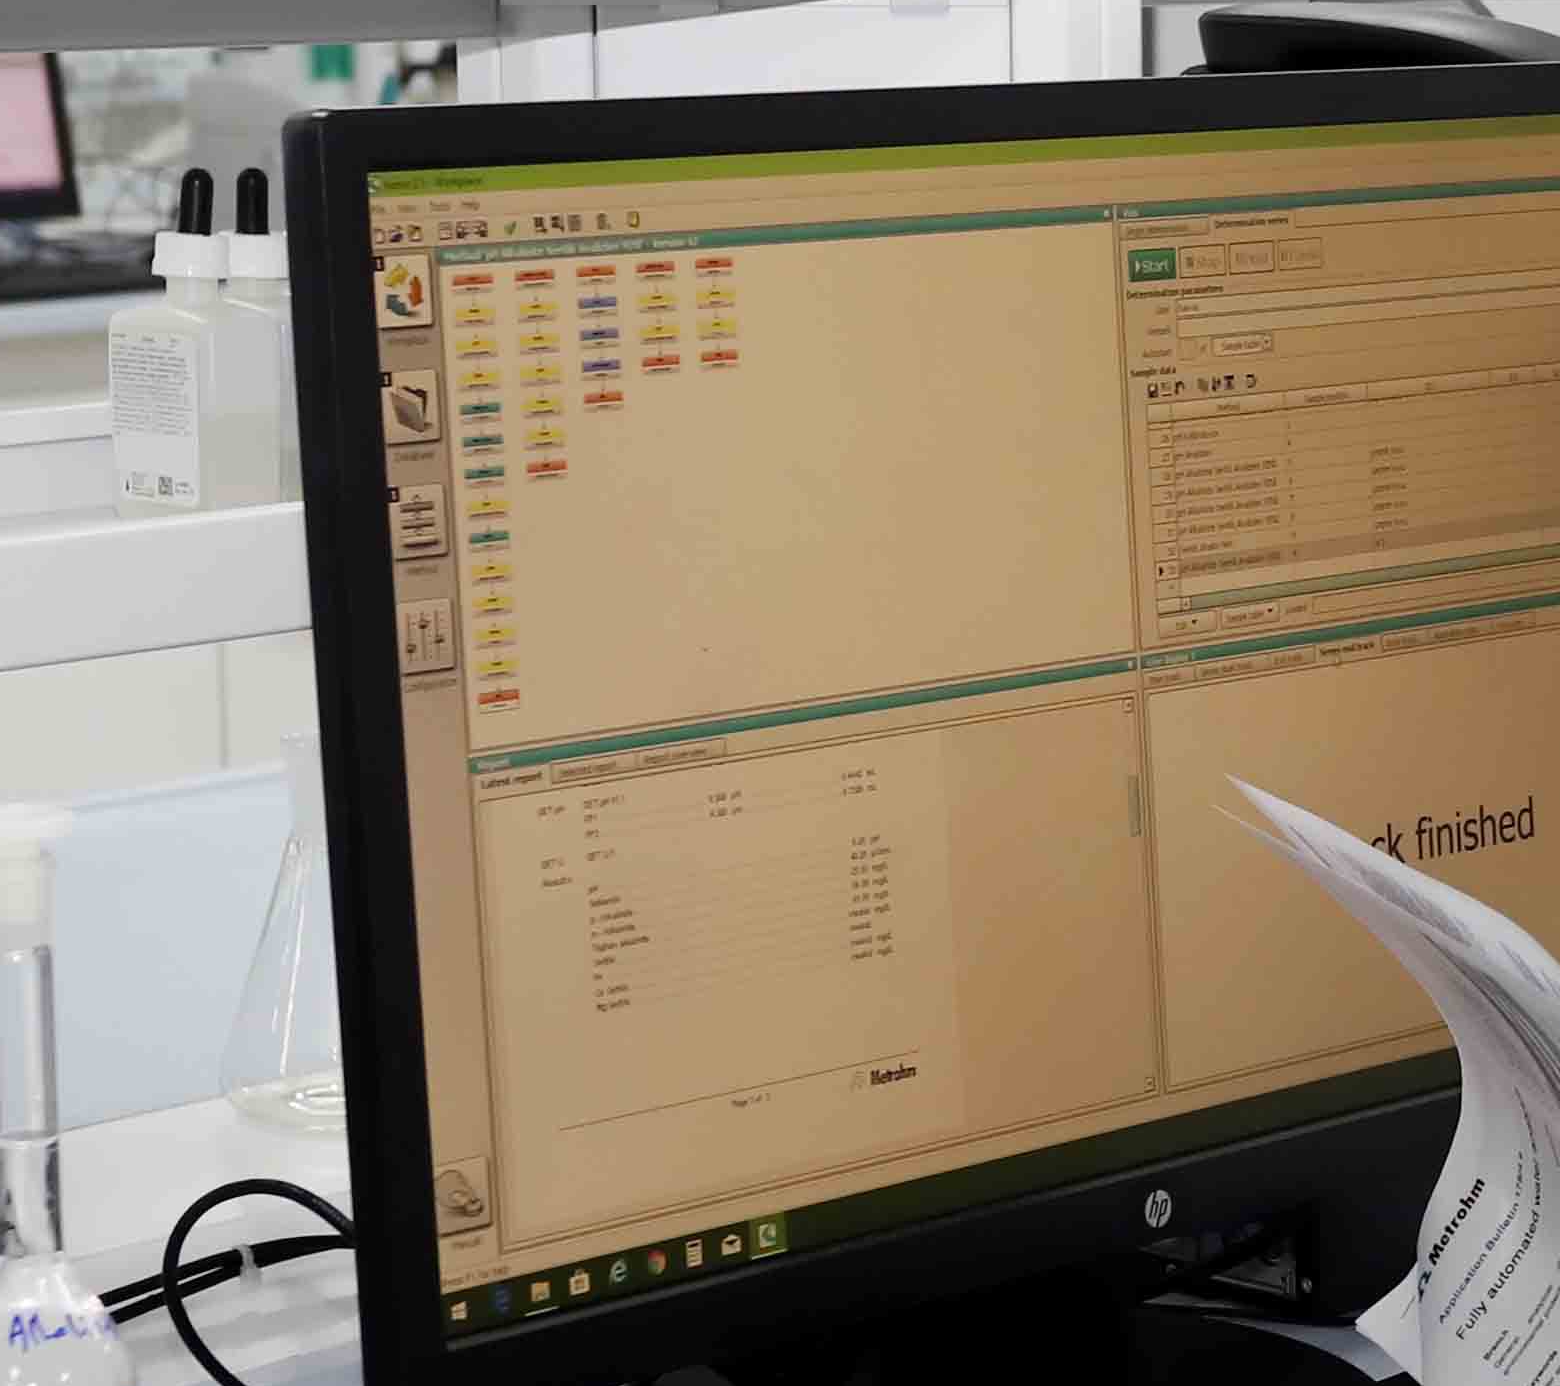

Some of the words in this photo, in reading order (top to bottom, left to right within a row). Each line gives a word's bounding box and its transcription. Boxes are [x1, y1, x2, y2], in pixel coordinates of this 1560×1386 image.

[1416, 795, 1535, 860] finished
[1144, 1189, 1172, 1228] hp
[1427, 1176, 1487, 1267] Metrohm
[1439, 1251, 1488, 1326] Application
[1485, 1201, 1520, 1252] Bulletin
[1456, 1299, 1488, 1341] Fully
[1487, 1210, 1540, 1300] automated
